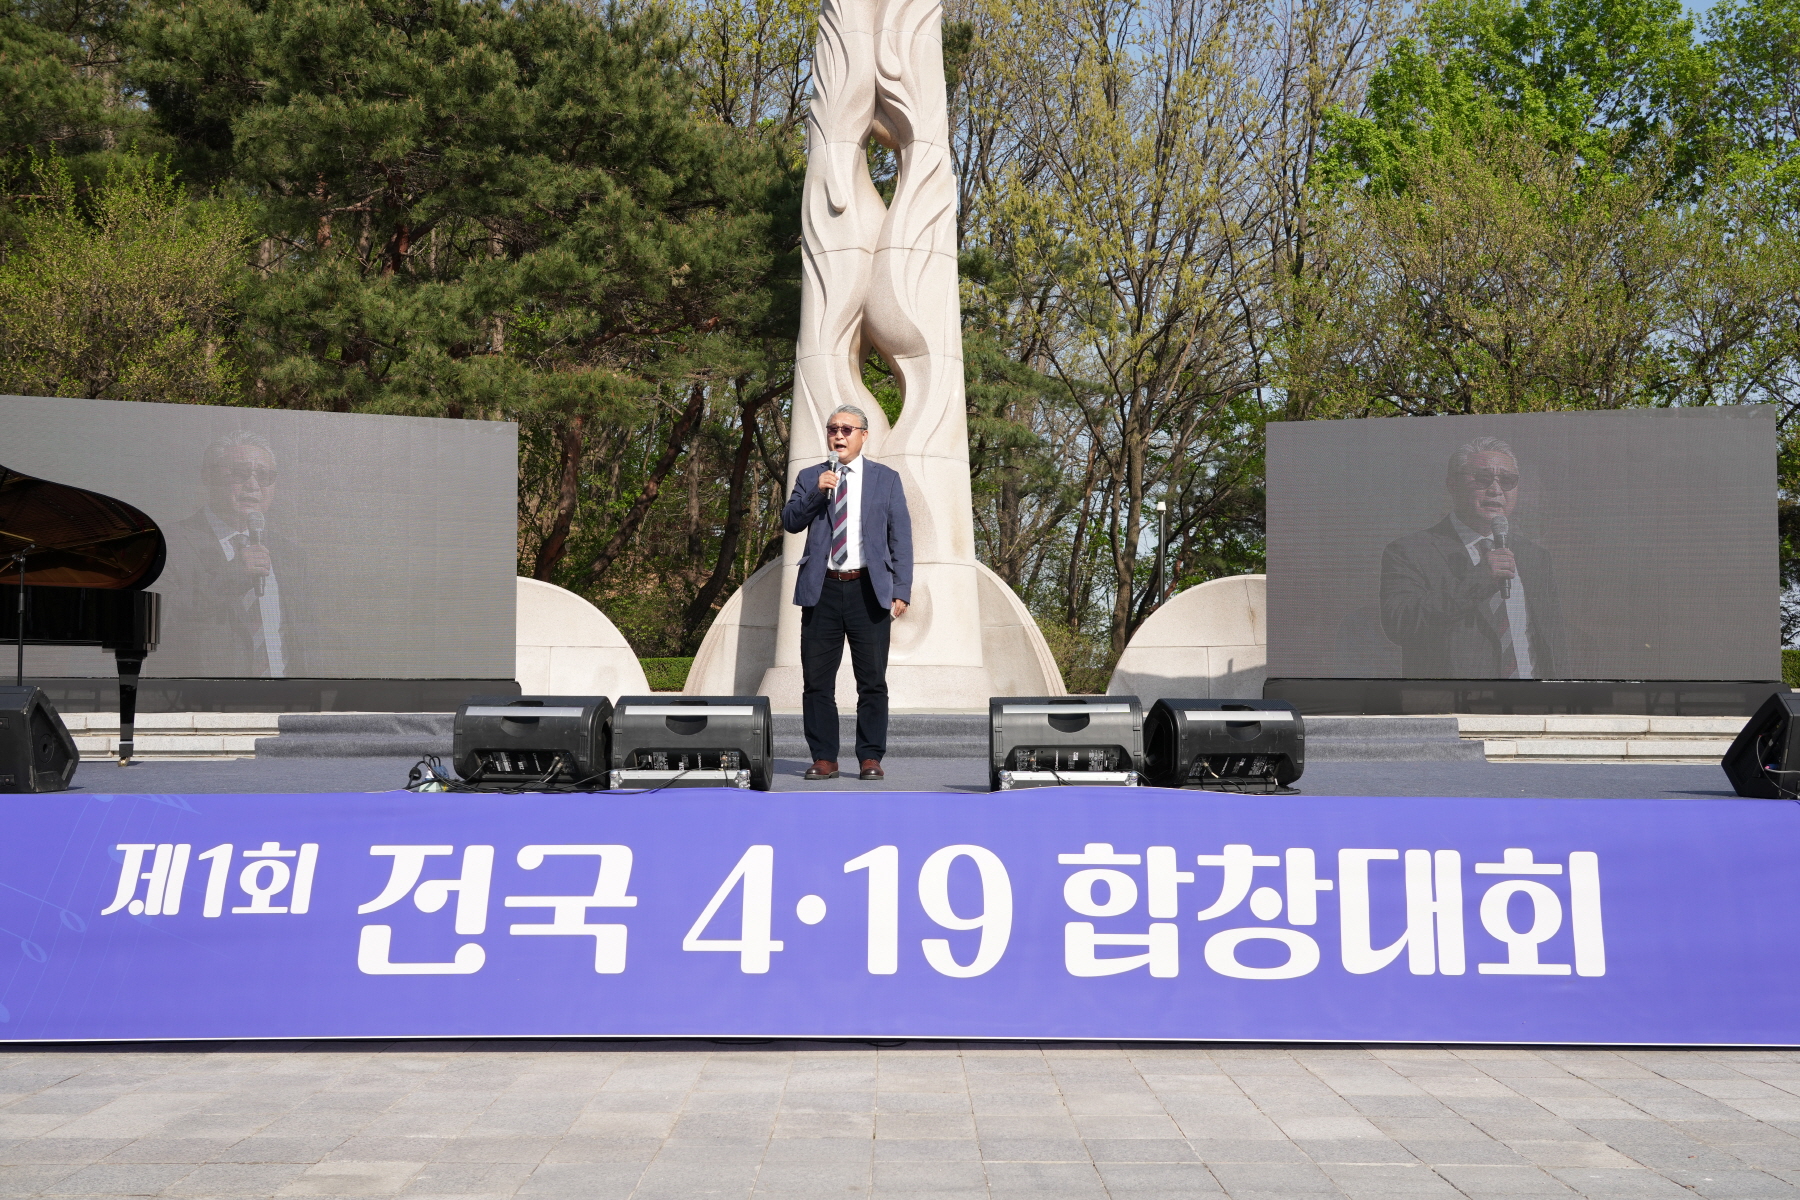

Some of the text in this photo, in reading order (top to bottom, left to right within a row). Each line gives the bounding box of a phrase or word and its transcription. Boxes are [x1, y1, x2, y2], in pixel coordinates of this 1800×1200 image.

[101, 842, 319, 918] 제1회
[357, 844, 638, 976] 전국
[1057, 842, 1606, 980] 합창대회
